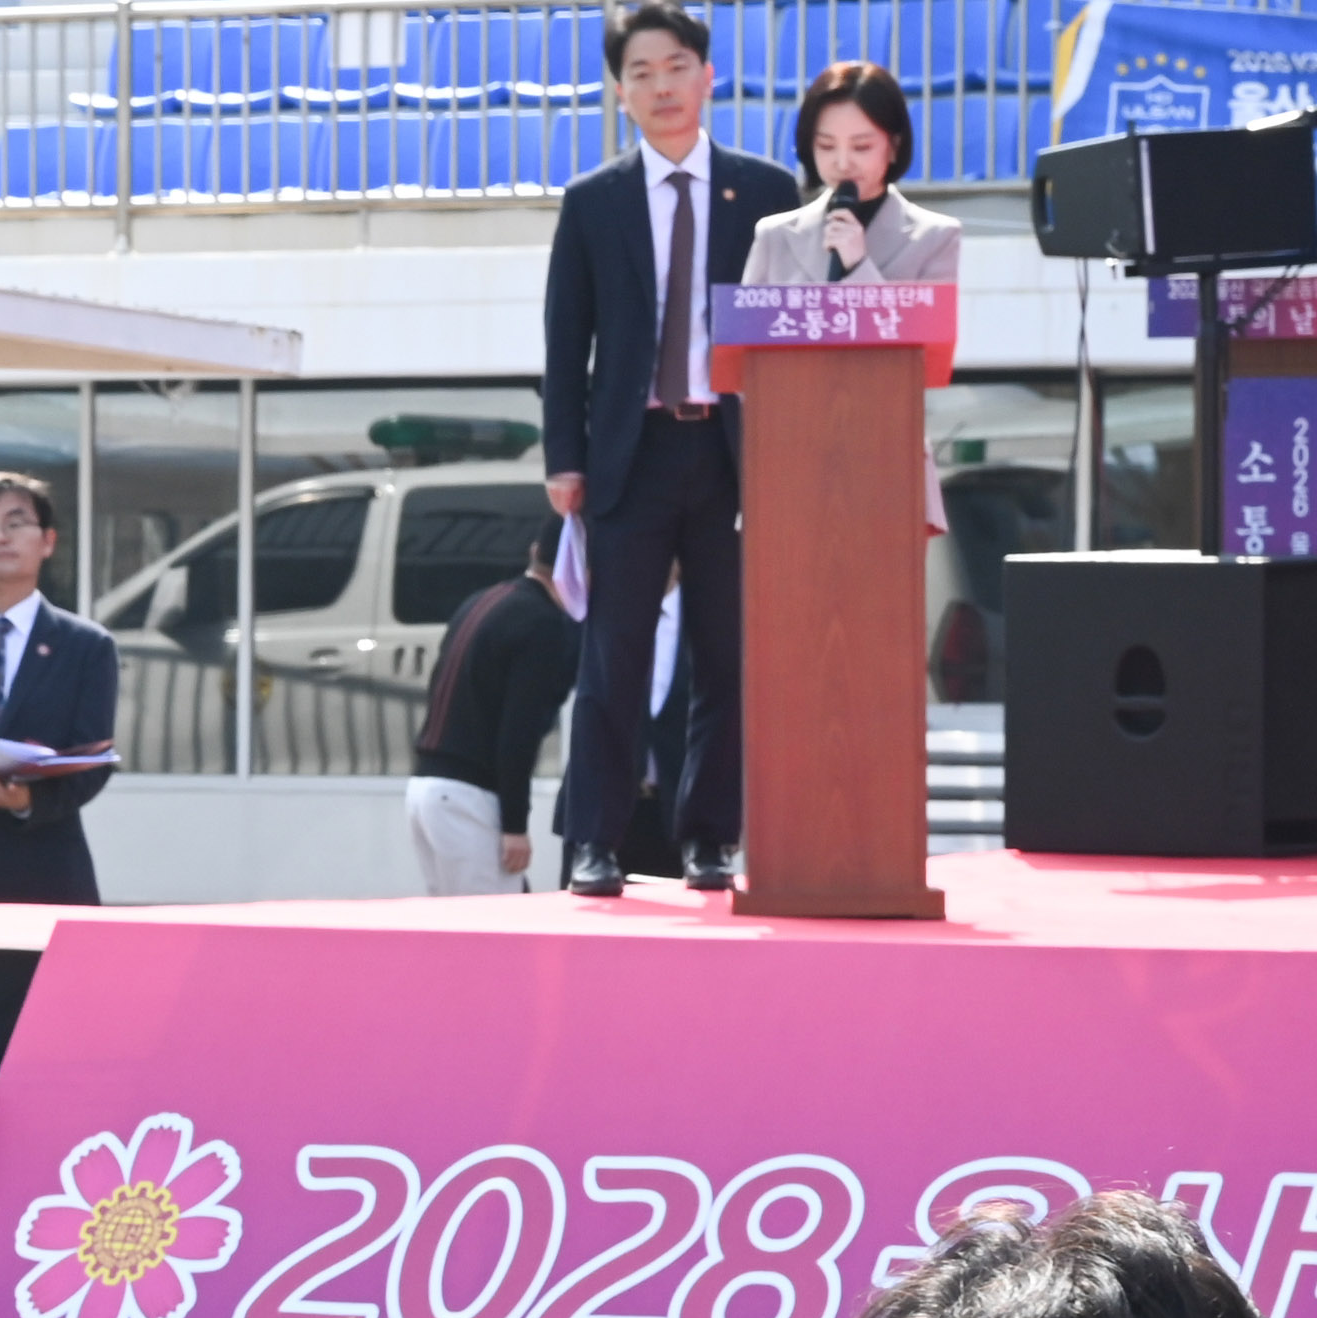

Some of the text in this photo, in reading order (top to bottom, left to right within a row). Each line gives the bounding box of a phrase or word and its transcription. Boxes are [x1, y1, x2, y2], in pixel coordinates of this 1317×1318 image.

[733, 286, 935, 309] 2026 울산 국민운동단체
[768, 307, 903, 341] 소통의 날
[1291, 416, 1310, 518] 2026
